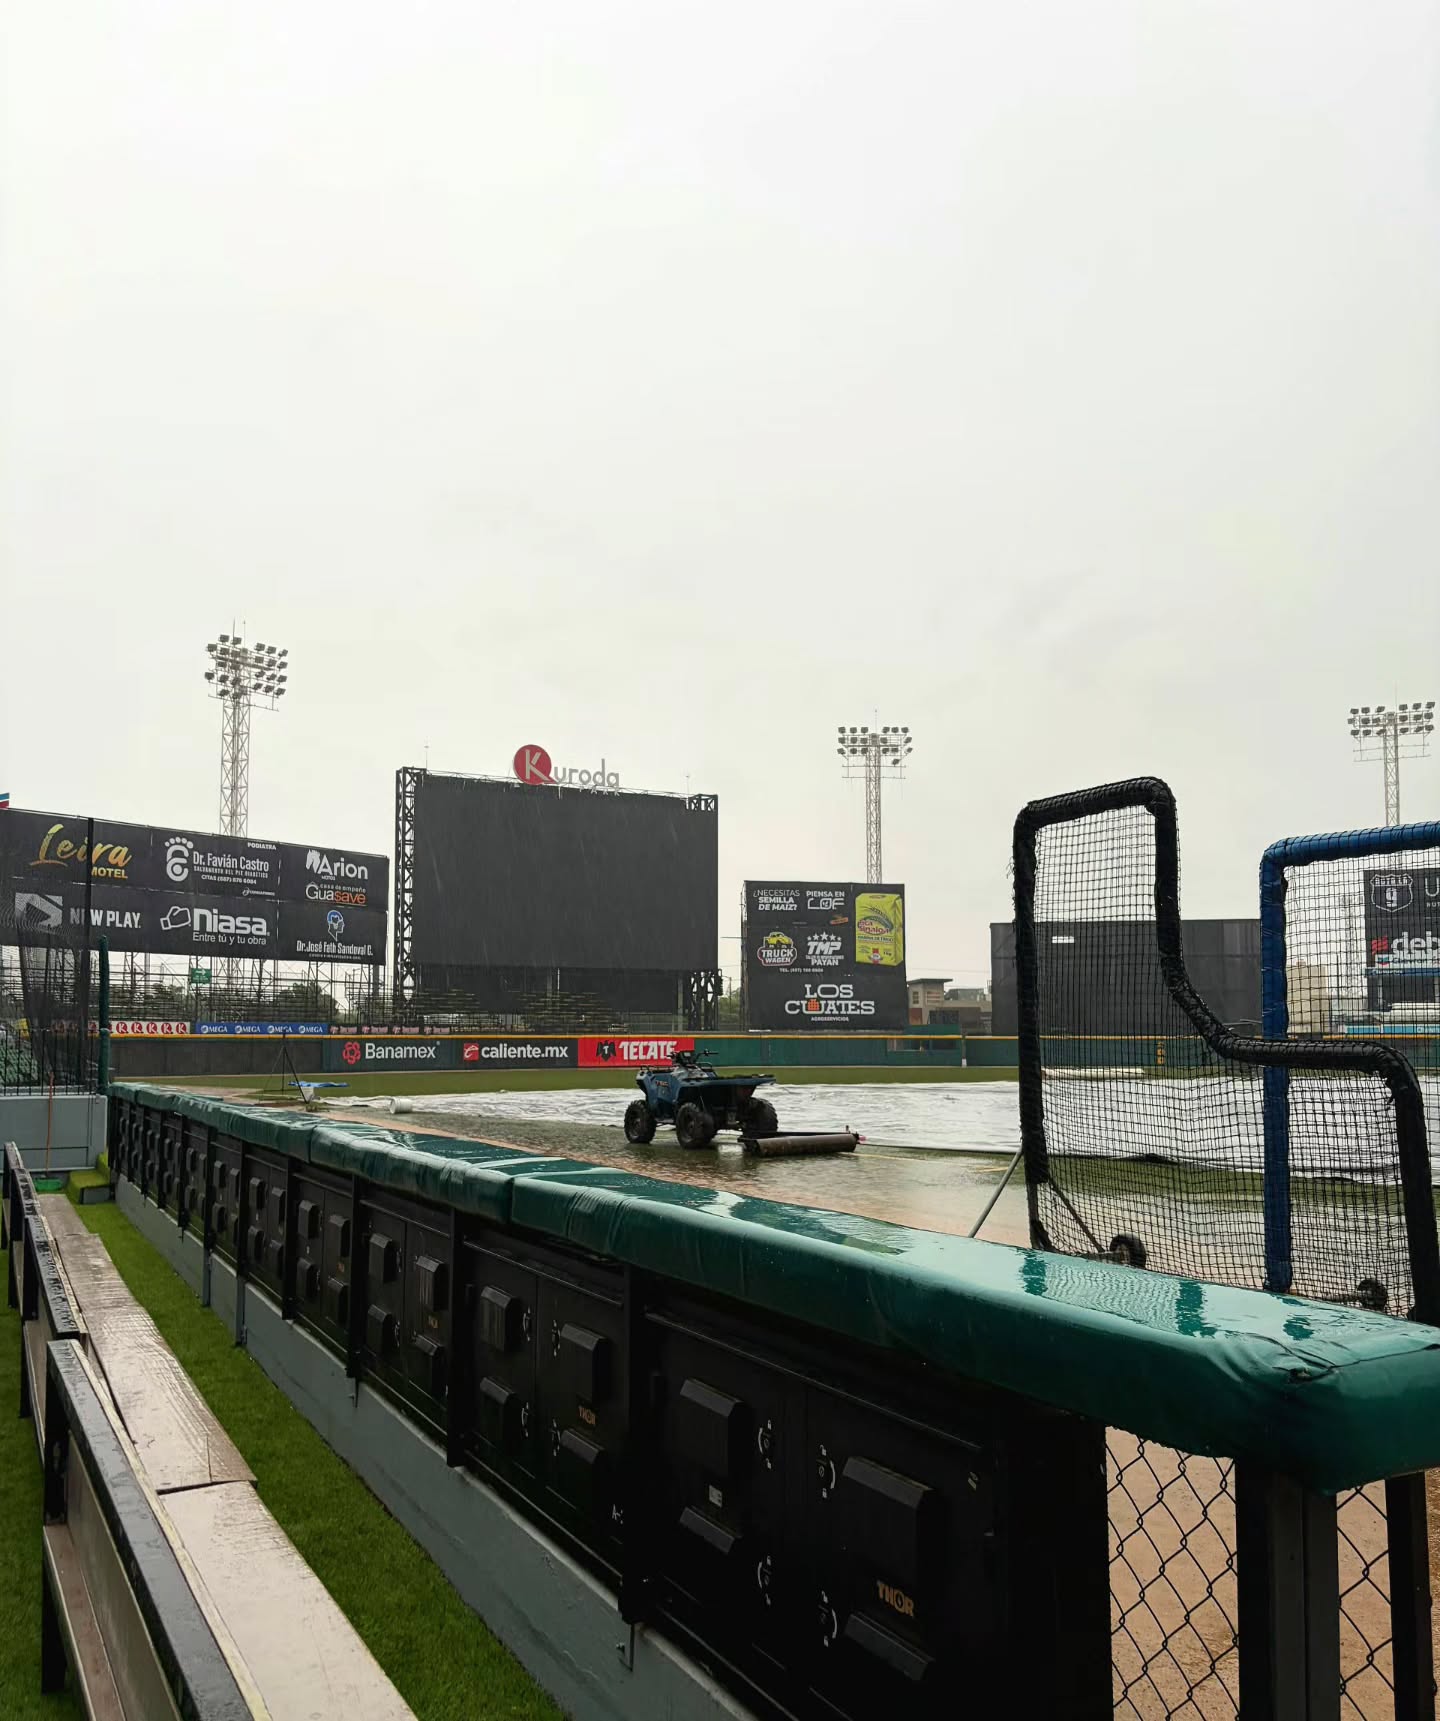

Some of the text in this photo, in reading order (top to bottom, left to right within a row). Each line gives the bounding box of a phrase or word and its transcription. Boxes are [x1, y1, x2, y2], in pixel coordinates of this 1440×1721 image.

[518, 746, 620, 788] Kuroda
[247, 842, 277, 850] PODIATRA
[193, 851, 269, 871] Dr. Favián Castro
[317, 854, 368, 880] Arion
[305, 882, 366, 904] Guasave
[806, 890, 833, 898] PIENSA
[758, 903, 770, 911] DE
[193, 932, 267, 945] Entre tú y tu obra
[761, 948, 794, 958] TRUCK
[807, 941, 842, 955] TMP
[804, 984, 854, 998] LOS
[784, 1000, 875, 1015] CUATES
[365, 1043, 436, 1059] Banamex
[481, 1043, 569, 1059] caliente.mx
[619, 1041, 677, 1060] TECATE
[876, 1579, 914, 1617] THOR
